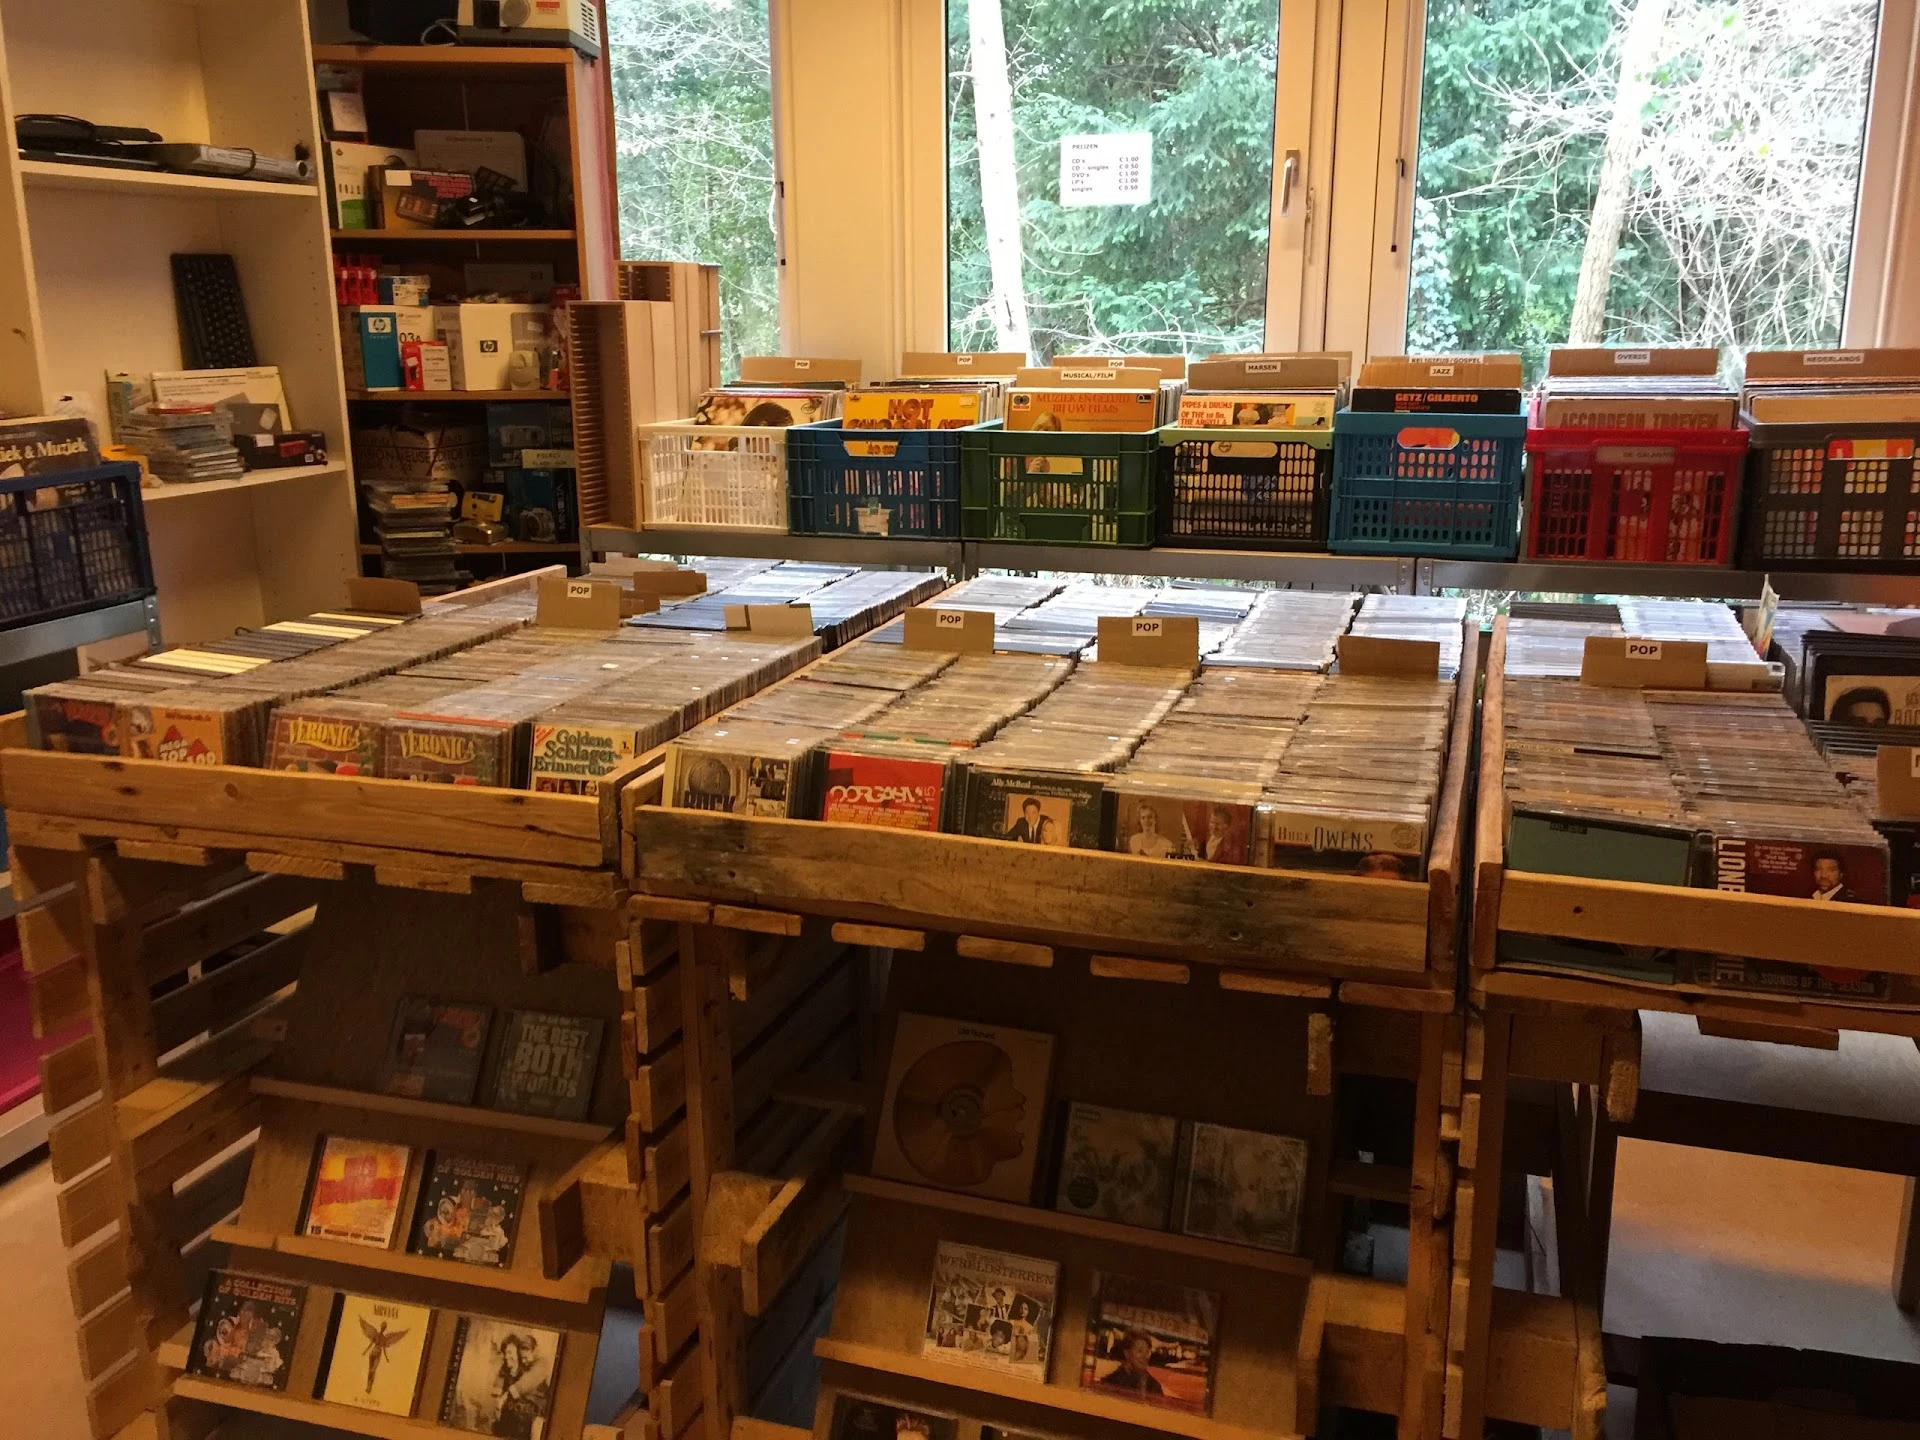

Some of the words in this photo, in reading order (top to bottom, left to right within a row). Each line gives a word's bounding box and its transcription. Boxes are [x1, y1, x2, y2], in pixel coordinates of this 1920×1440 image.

[1616, 353, 1648, 361] OVERIG
[1806, 355, 1862, 363] NEDERLANDS
[1432, 367, 1451, 375] JAZZ
[1036, 394, 1076, 403] MUZIEK
[1077, 394, 1089, 403] EN
[1395, 393, 1479, 403] GETZ/GILBERTO
[887, 398, 934, 421] HOT
[1053, 404, 1066, 414] BIJ
[1068, 404, 1086, 413] UW
[1088, 404, 1119, 413] FILMS
[1181, 401, 1202, 409] PIPES
[1181, 411, 1190, 419] OF
[1191, 411, 1205, 419] THE
[1181, 418, 1195, 426] THE
[24, 445, 35, 459] &
[36, 436, 88, 458] Muziek
[571, 585, 589, 596] POP
[940, 614, 962, 625] POP
[1135, 622, 1160, 633] POP
[1629, 644, 1658, 655] POP
[289, 717, 361, 746] VERONICA
[556, 729, 614, 748] Goldene
[399, 729, 476, 760] VERONICA
[544, 740, 623, 764] Schlager-
[990, 778, 1004, 788] Ally
[1005, 779, 1031, 789] McBeal
[1314, 826, 1374, 852] OWENS
[1761, 971, 1799, 988] SOUNDS
[1801, 975, 1814, 988] OF
[513, 1041, 584, 1078] BOTH
[939, 1252, 1054, 1284] WERELDSTERREN
